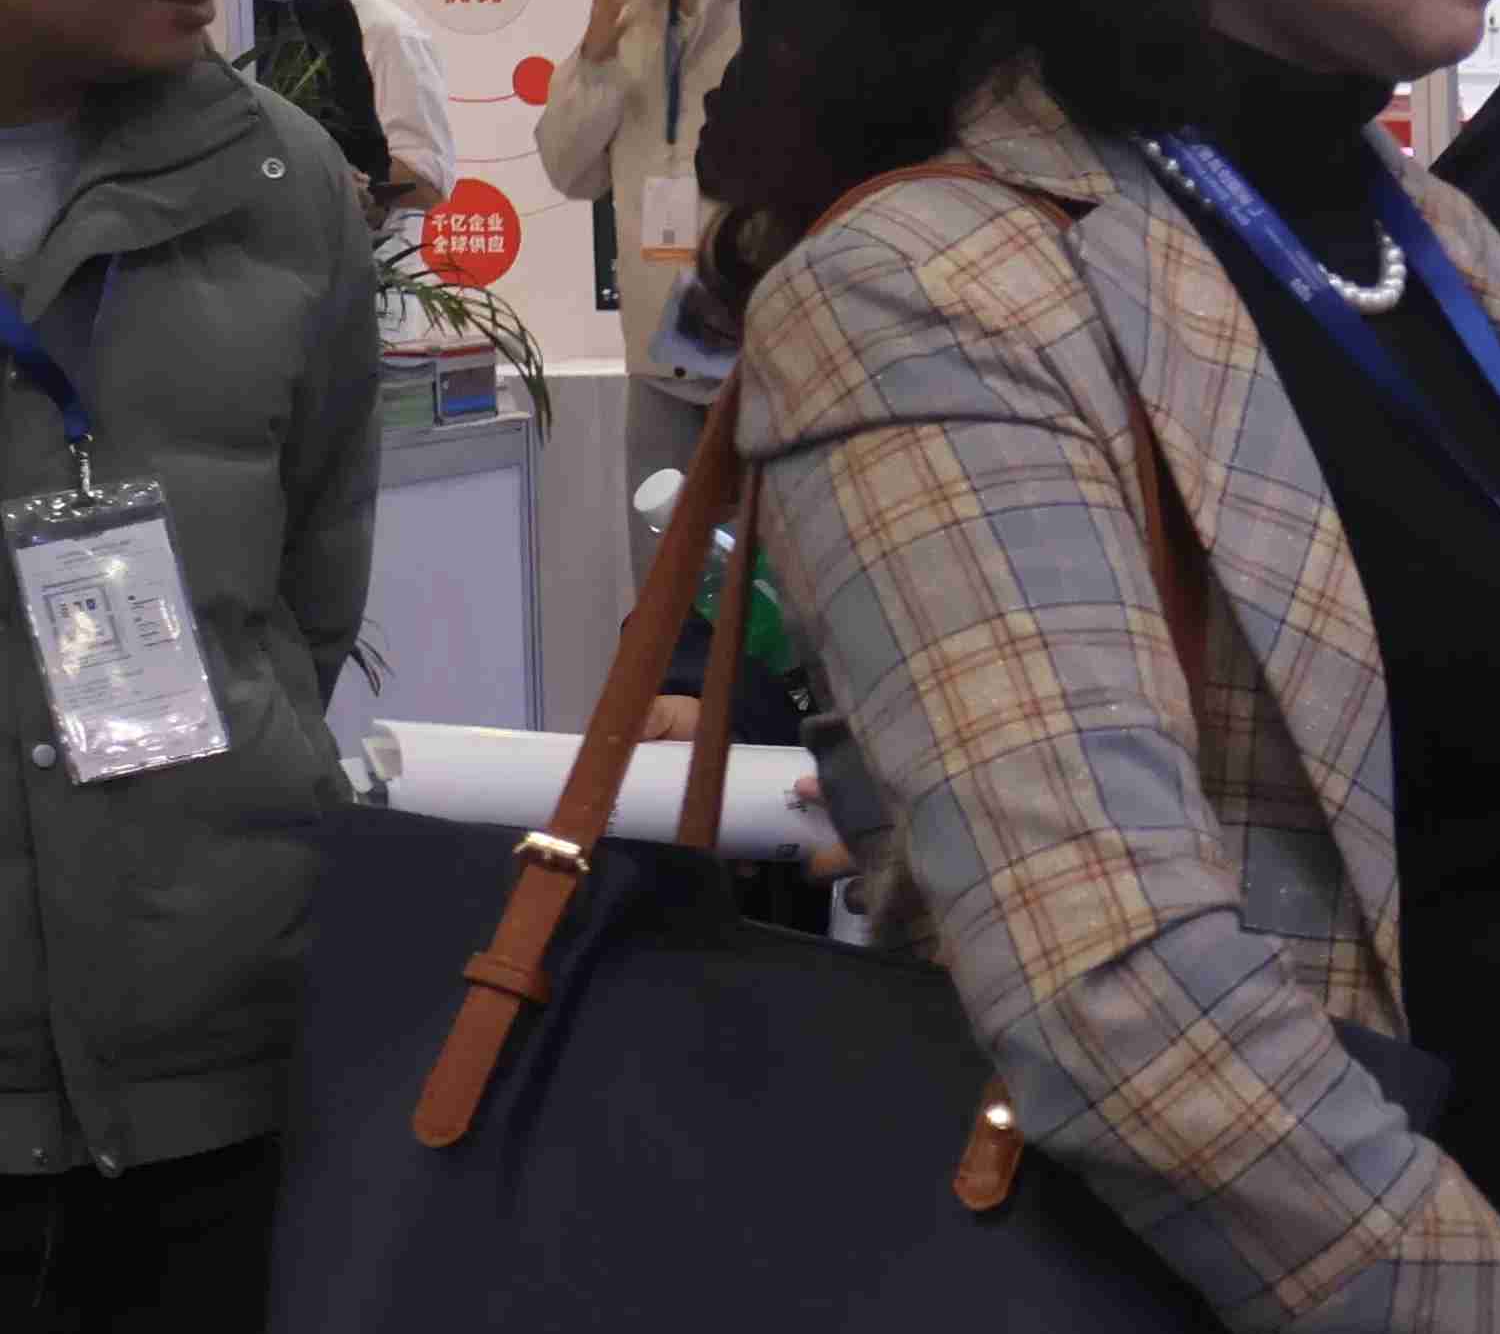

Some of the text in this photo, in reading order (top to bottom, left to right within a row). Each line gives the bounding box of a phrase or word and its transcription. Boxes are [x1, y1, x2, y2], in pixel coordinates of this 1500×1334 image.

[431, 212, 505, 233] 千亿企业
[431, 234, 505, 255] 全球供应
